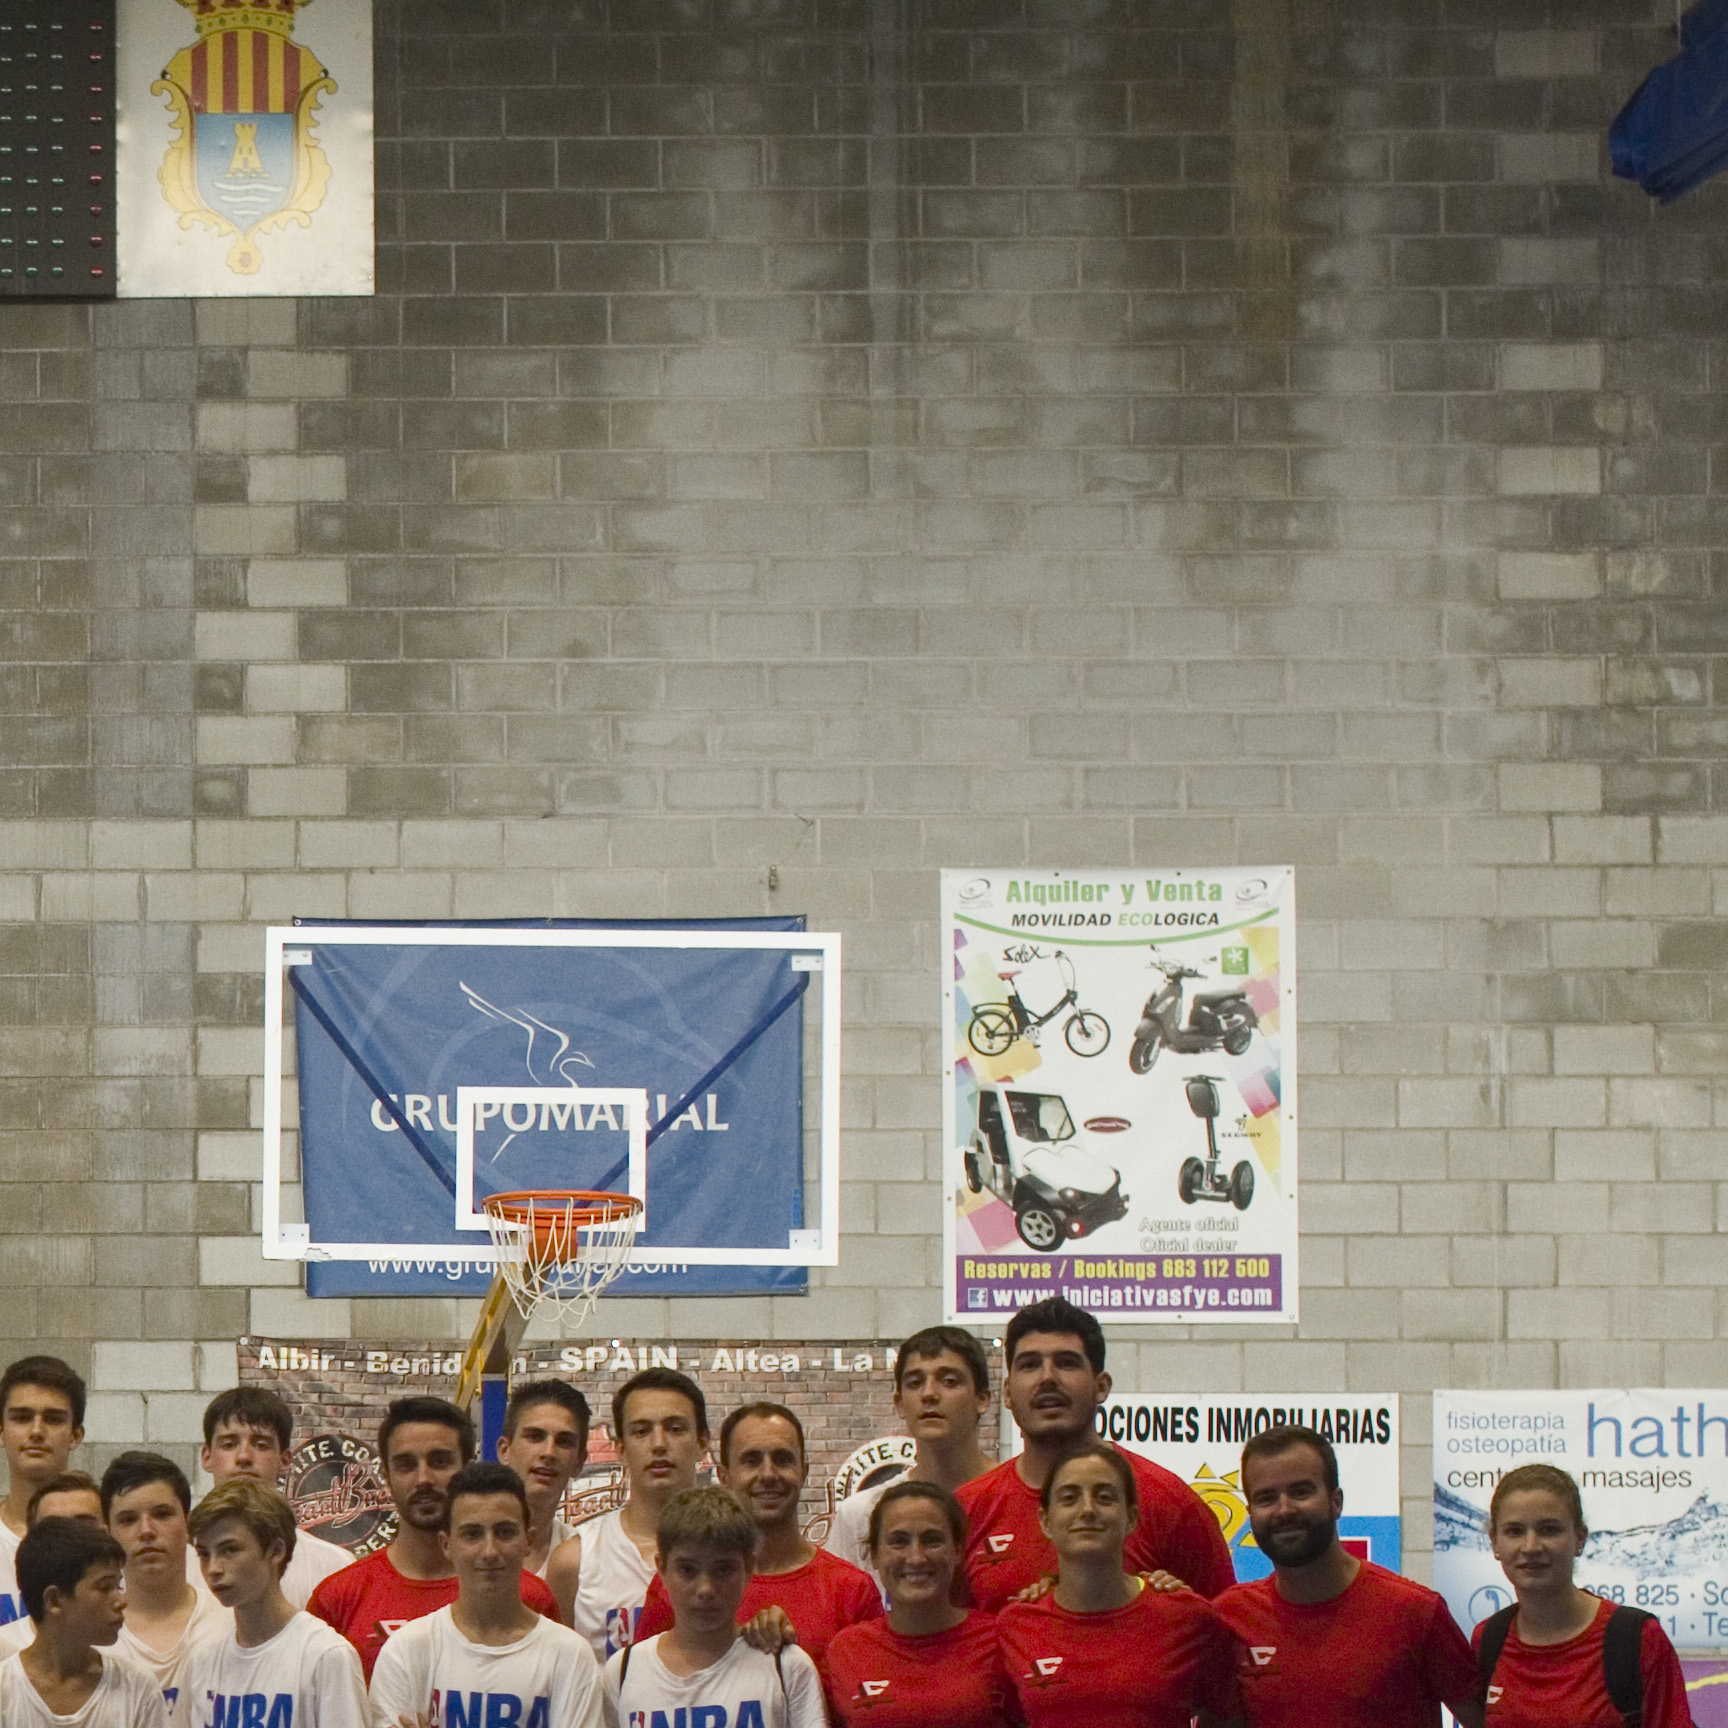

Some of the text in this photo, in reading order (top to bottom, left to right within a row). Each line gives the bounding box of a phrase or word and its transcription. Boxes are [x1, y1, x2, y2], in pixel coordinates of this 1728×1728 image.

[1006, 880, 1109, 905] Alquiler
[1121, 884, 1134, 904] y
[1146, 880, 1222, 902] Venta
[1012, 912, 1219, 926] MOVILIDAD ECOLOGICA
[1139, 1217, 1191, 1233] Agente
[1194, 1238, 1238, 1252] dealer
[964, 1258, 1270, 1281] Reservas Bookings 683 112 500
[993, 1285, 1273, 1309] wwwiniciativasfye.com
[258, 1346, 335, 1371] Albir
[560, 1346, 678, 1372] SPAIN
[711, 1348, 800, 1372] Altea
[834, 1348, 873, 1372] La
[1095, 1405, 1199, 1443] OCIONES
[1447, 1411, 1565, 1433] fisioterapia
[1447, 1434, 1567, 1457] osteopatía
[1583, 1466, 1692, 1493] masajes
[1636, 1584, 1680, 1606] 825
